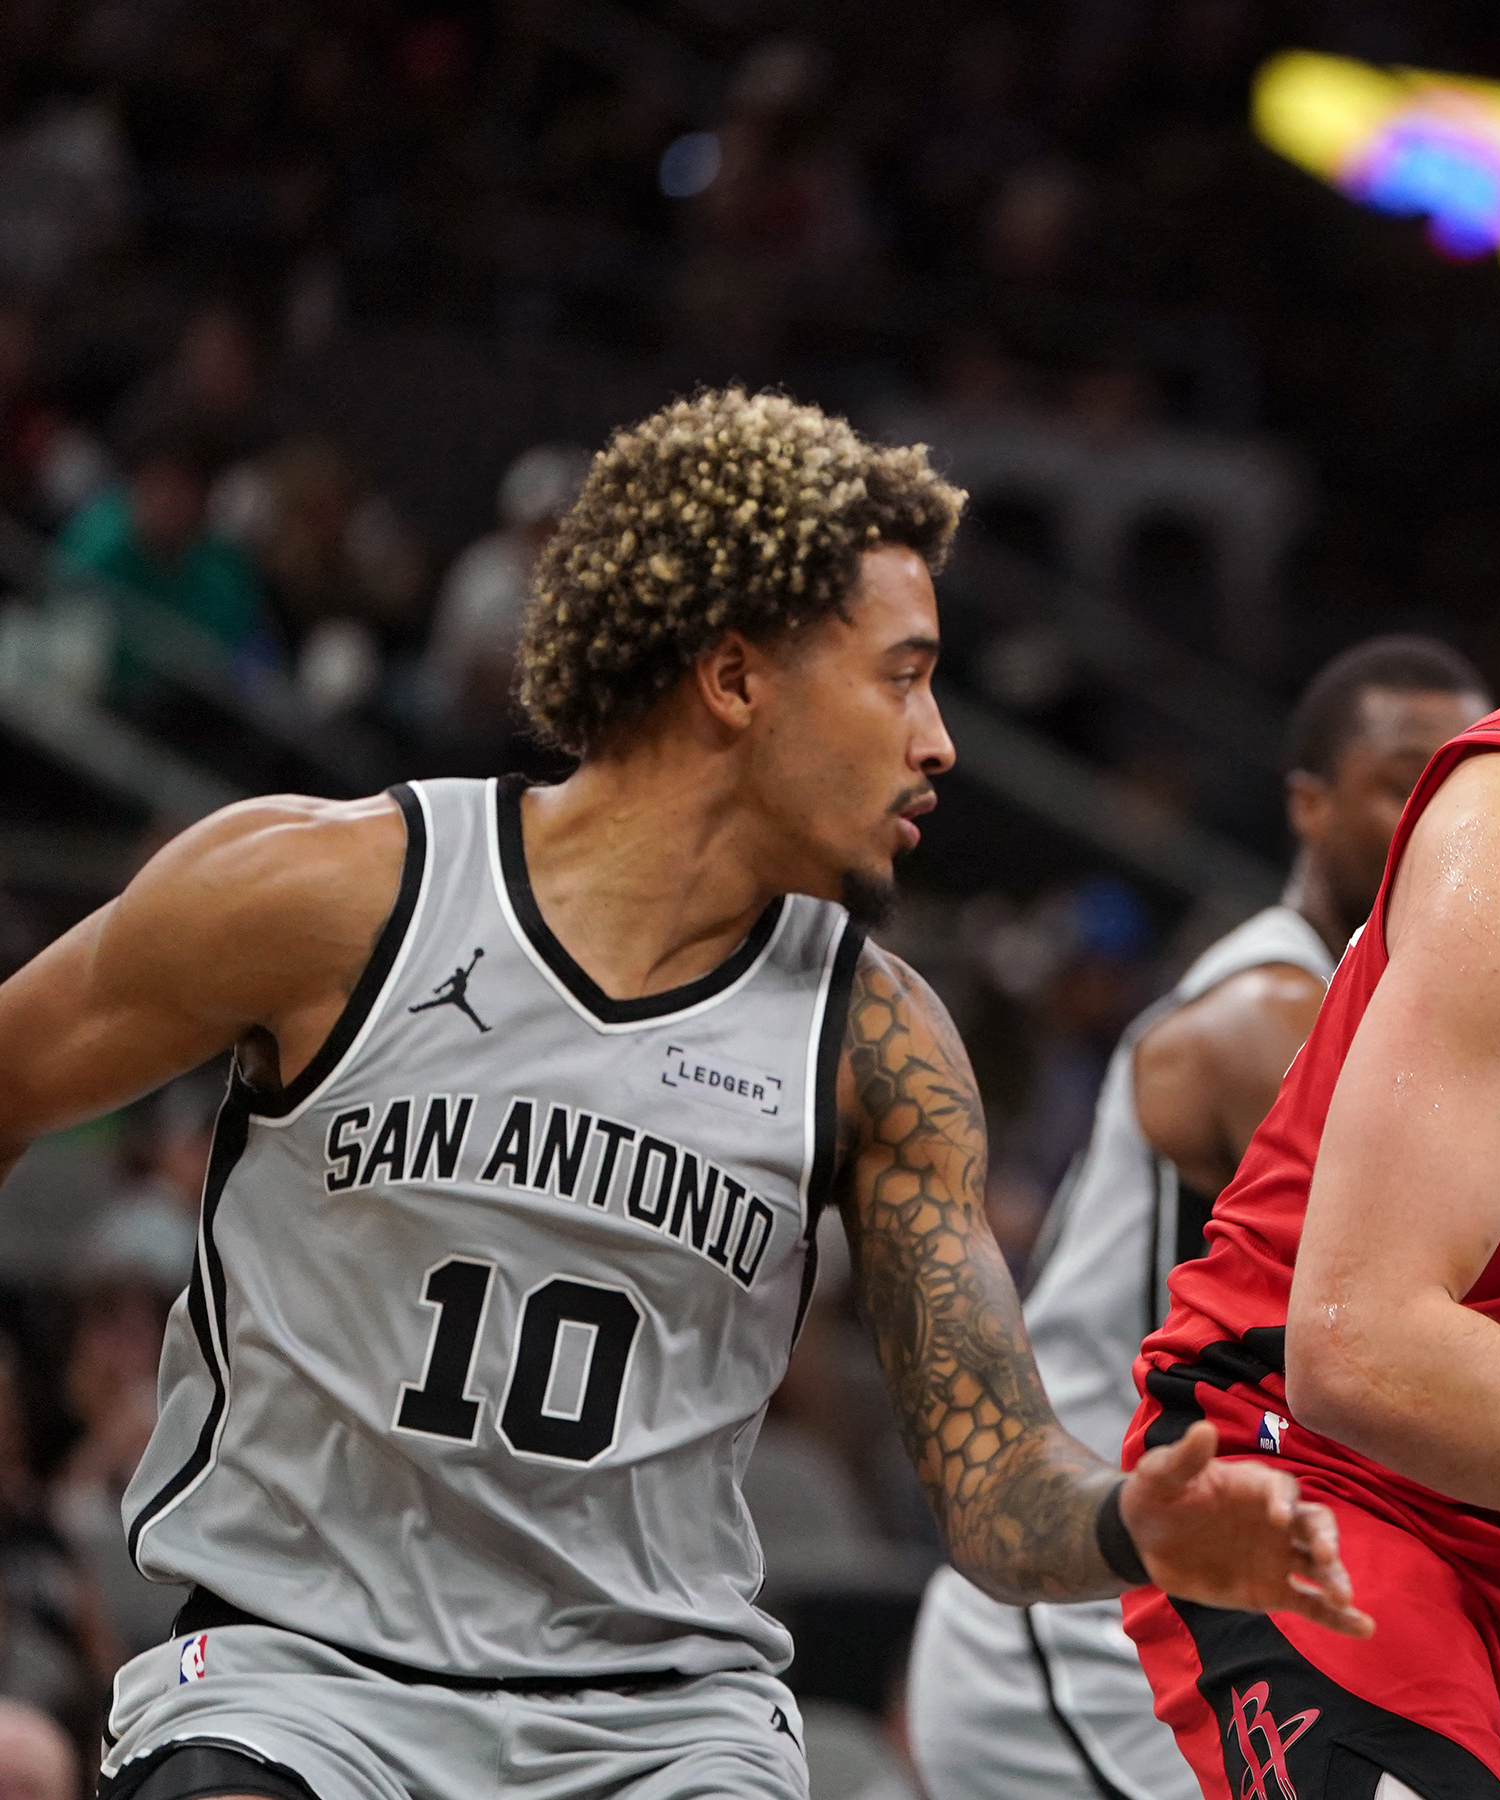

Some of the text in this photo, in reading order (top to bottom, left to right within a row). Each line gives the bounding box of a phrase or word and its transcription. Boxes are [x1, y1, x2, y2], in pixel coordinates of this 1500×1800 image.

[679, 1060, 765, 1101] LEDGER
[323, 1094, 776, 1293] SAN ANTONIO
[391, 1252, 646, 1468] 10
[1260, 1437, 1274, 1450] NBA
